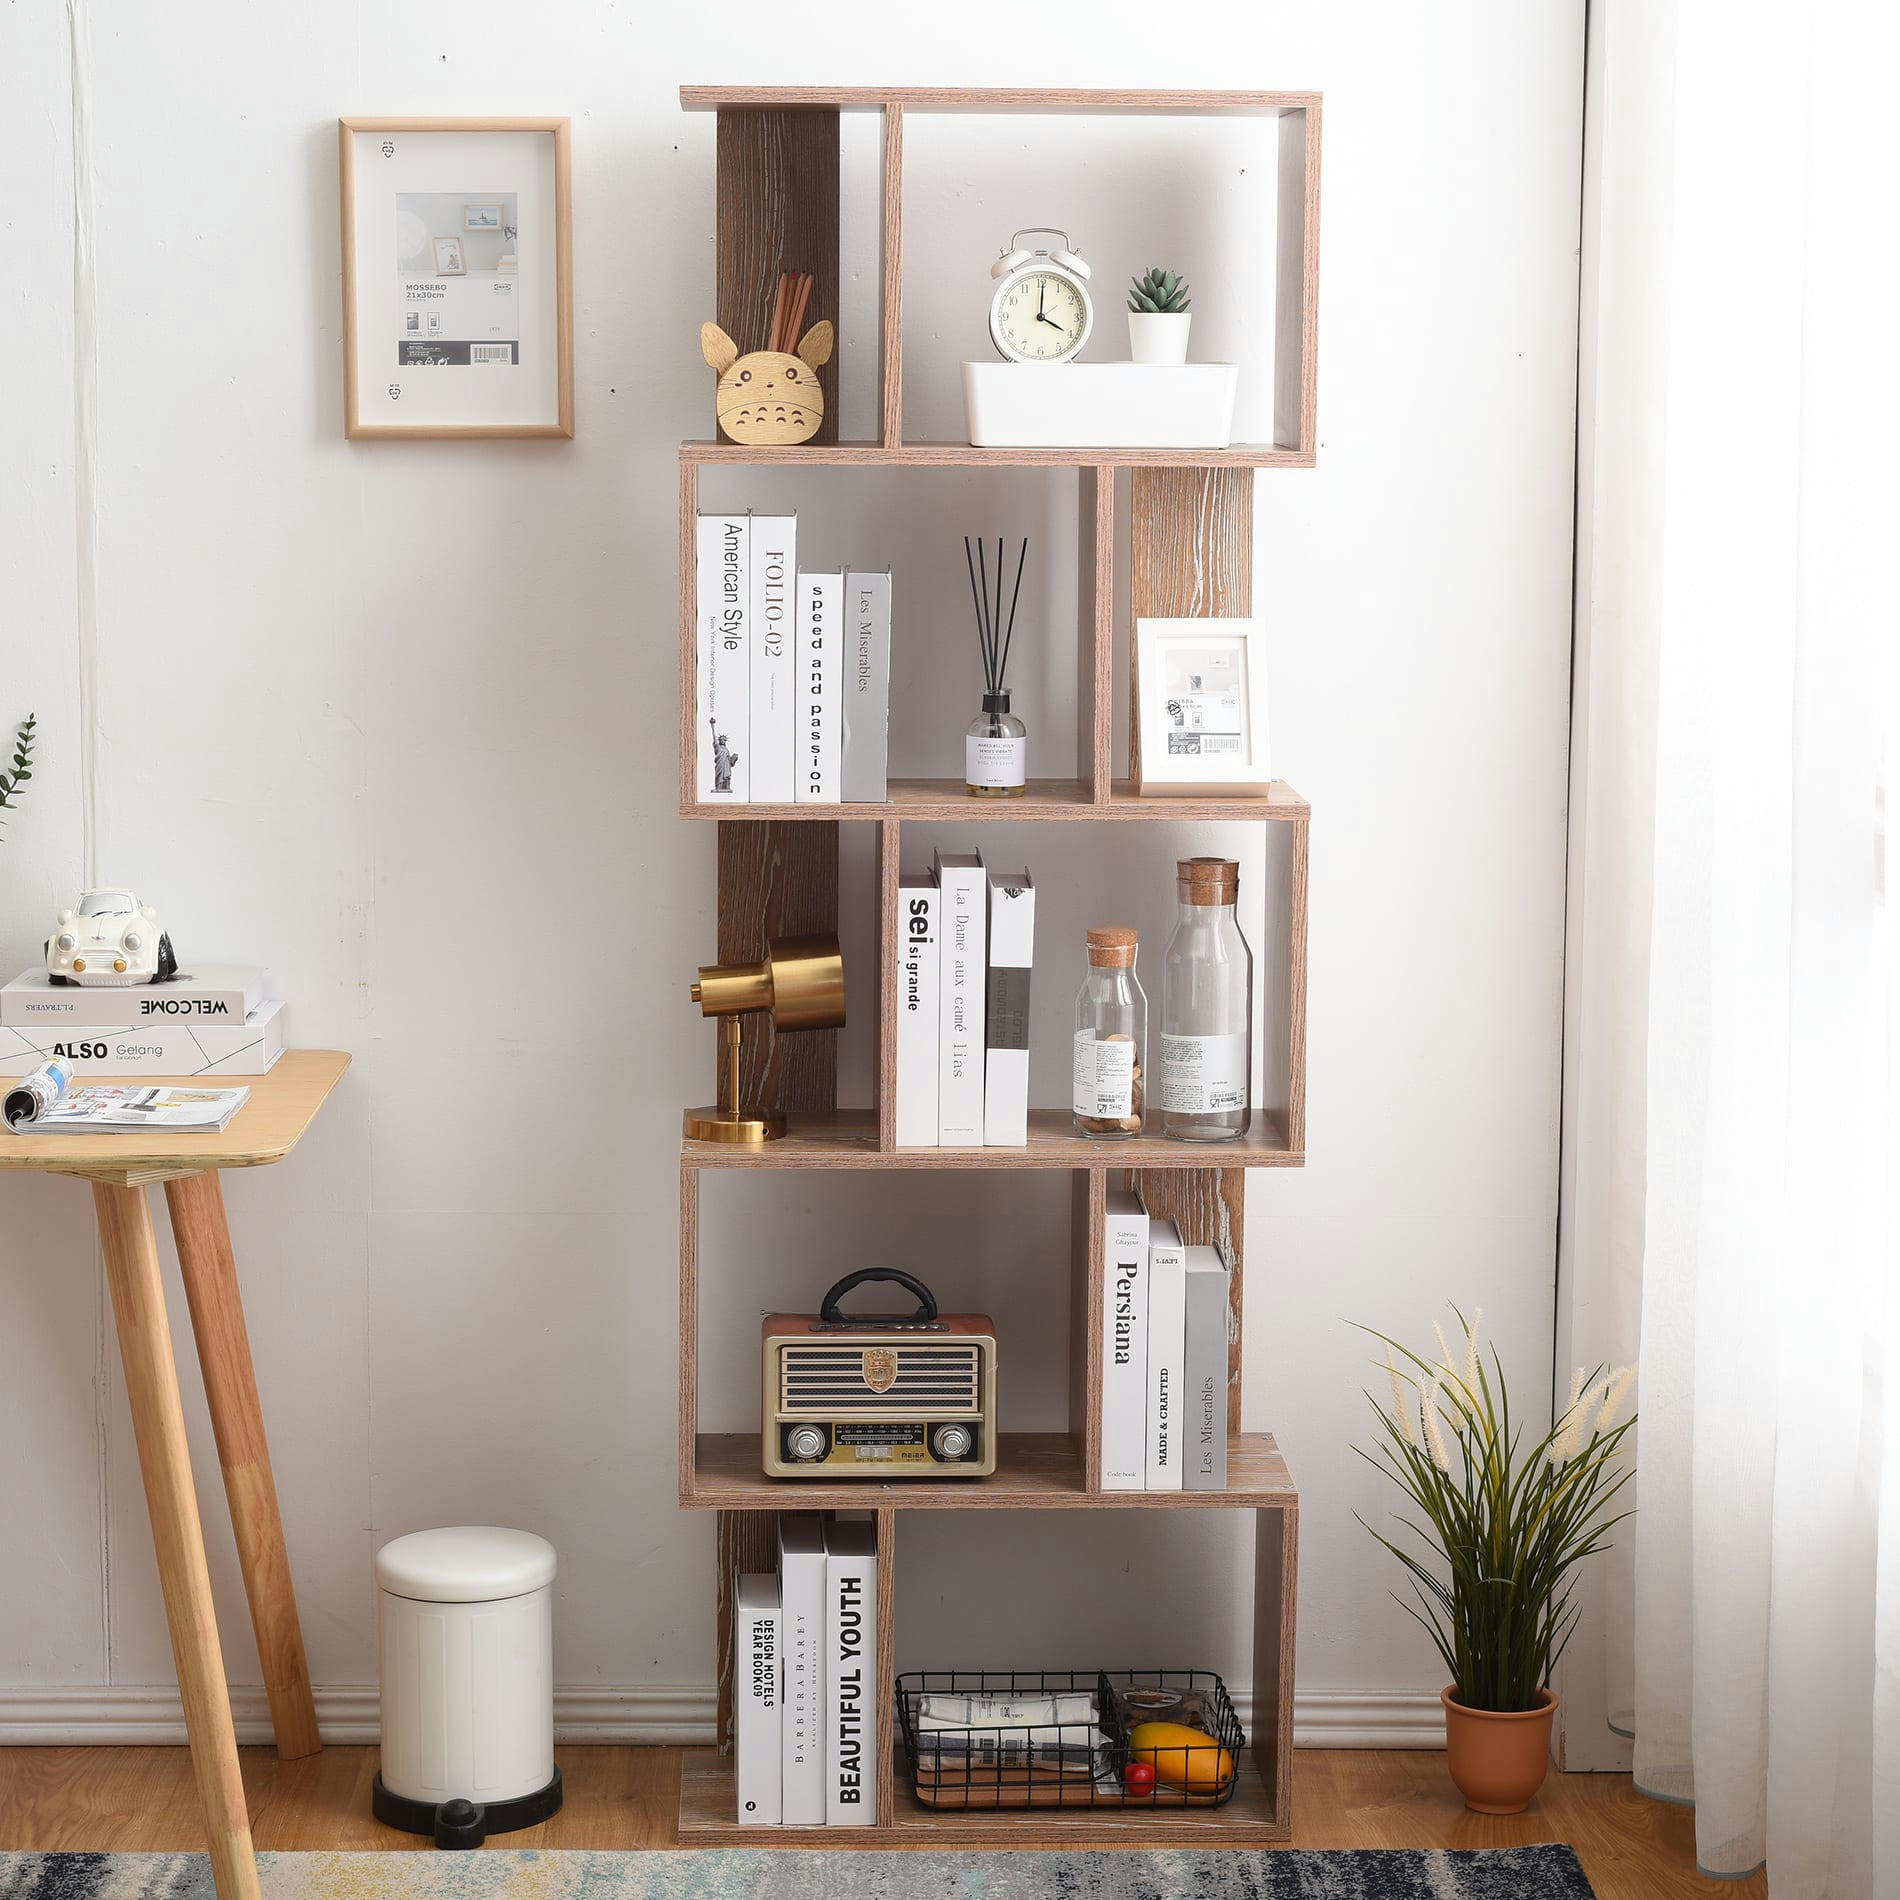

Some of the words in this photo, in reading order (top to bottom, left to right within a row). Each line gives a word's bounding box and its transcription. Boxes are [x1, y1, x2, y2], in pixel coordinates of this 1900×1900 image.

[1009, 296, 1018, 306] 10
[1021, 284, 1029, 294] 11
[1037, 279, 1047, 289] 12
[1056, 284, 1061, 293] 1
[1068, 296, 1075, 305] 2
[1002, 312, 1009, 321] 9
[1073, 313, 1080, 323] 3
[1007, 329, 1015, 339] 8
[1021, 341, 1028, 351] 7
[1037, 346, 1044, 356] 6
[1055, 342, 1062, 352] 5
[1067, 329, 1073, 339] 4
[724, 523, 743, 603] American
[764, 551, 784, 657] FOLIO-02
[811, 586, 823, 649] speed
[859, 591, 873, 614] Les
[719, 609, 743, 650] Style
[858, 622, 872, 692] Miserables
[811, 659, 822, 694] and
[810, 704, 822, 793] passion
[956, 888, 970, 905] La
[909, 899, 934, 943] sei
[955, 915, 969, 951] Dame
[909, 947, 921, 959] si
[906, 962, 921, 1011] grande
[954, 960, 965, 987] aux
[141, 1000, 228, 1015] WELCOME
[954, 997, 967, 1032] camé
[53, 1043, 108, 1059] ALSO
[116, 1044, 163, 1058] Gelang
[952, 1044, 967, 1078] lias
[1115, 1262, 1138, 1365] Persiana
[1159, 1368, 1169, 1420] CRAFTED
[1200, 1376, 1214, 1444] Miserables
[1159, 1422, 1168, 1431] &
[1158, 1432, 1168, 1466] MADE
[1200, 1451, 1213, 1474] Les
[752, 1620, 763, 1649] YEAR
[840, 1577, 861, 1662] YOUTH
[763, 1620, 774, 1660] DESIGN
[796, 1615, 805, 1672] BAREY
[763, 1665, 774, 1707] HOTELS
[794, 1680, 805, 1763] BARBERA
[840, 1668, 861, 1804] BEAUTIFUL
